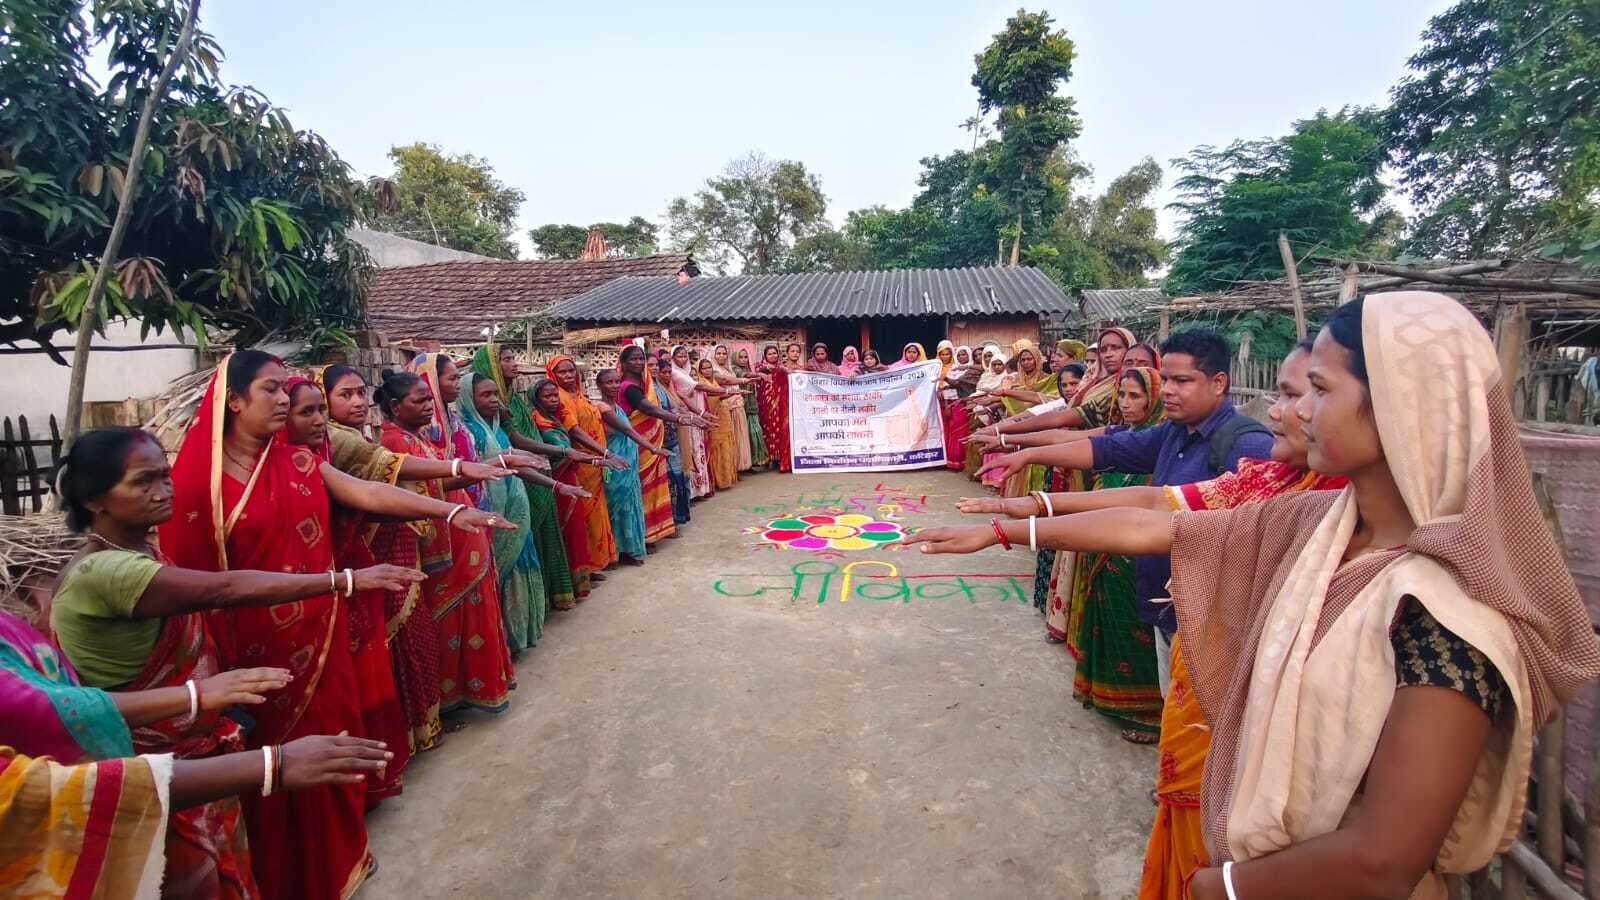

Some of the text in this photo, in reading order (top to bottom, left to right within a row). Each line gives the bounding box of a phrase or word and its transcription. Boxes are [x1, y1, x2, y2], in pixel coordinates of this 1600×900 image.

[819, 416, 867, 428] आपका मत
[815, 428, 874, 440] आपकी ताकत
[713, 561, 1034, 604] जीविका
